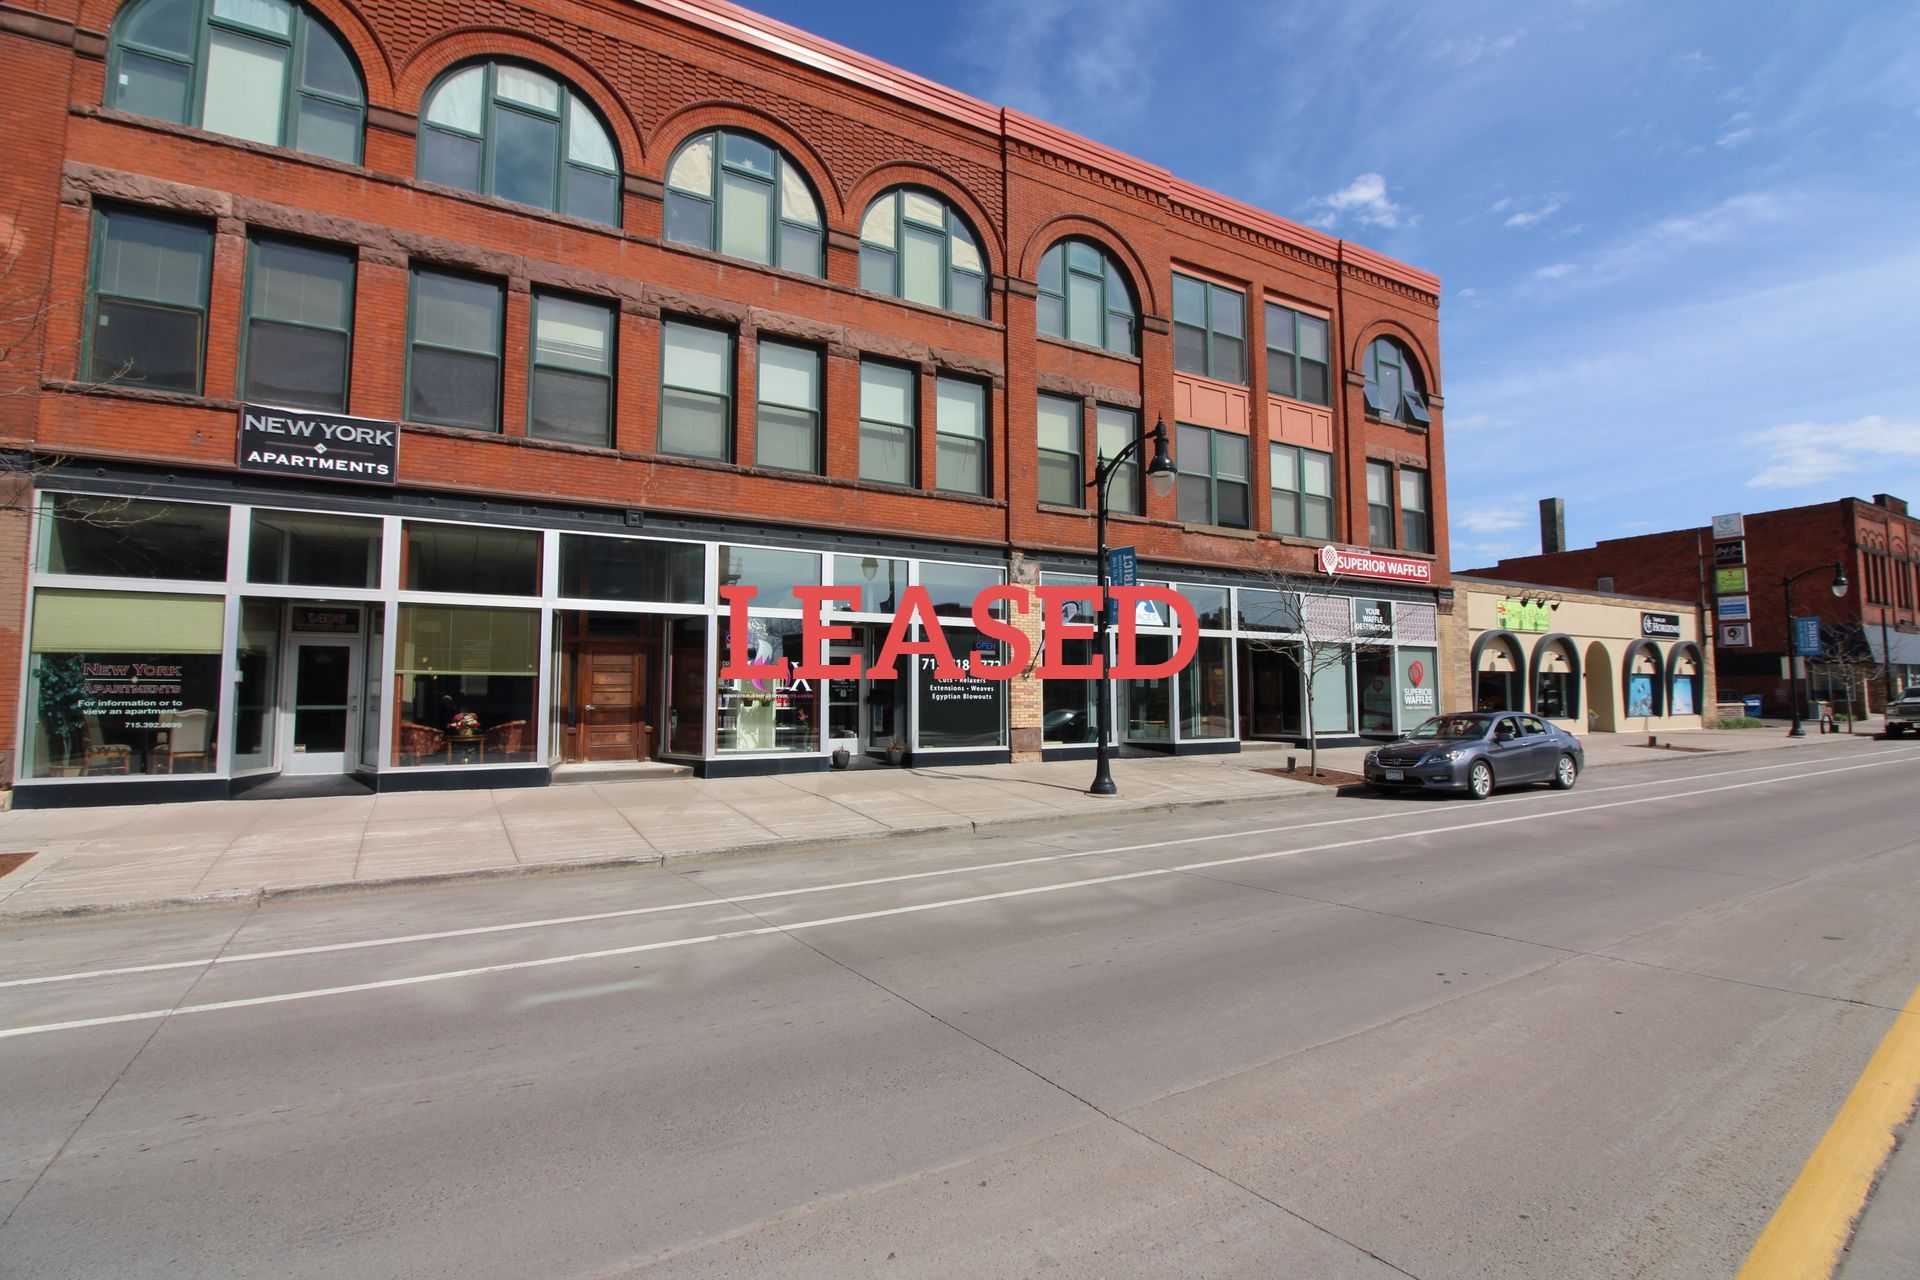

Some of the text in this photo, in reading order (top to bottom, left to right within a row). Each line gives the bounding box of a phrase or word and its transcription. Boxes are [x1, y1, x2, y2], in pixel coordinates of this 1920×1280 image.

[245, 414, 394, 447] NEW YORK
[248, 451, 389, 475] APARTMENTS
[1338, 556, 1428, 577] SUPERIOR WAFFLES
[1362, 615, 1383, 623] WAFFLE
[1355, 623, 1390, 632] DESTINATION
[1808, 621, 1818, 647] DISTRICT
[975, 642, 996, 650] OPEN
[83, 663, 182, 676] NEW YORK
[81, 684, 181, 693] APARTMENTS
[1403, 688, 1432, 696] SUPERIOR
[932, 693, 961, 701] Egyptian
[1405, 696, 1432, 705] WAFFLES
[125, 708, 177, 716] apartment
